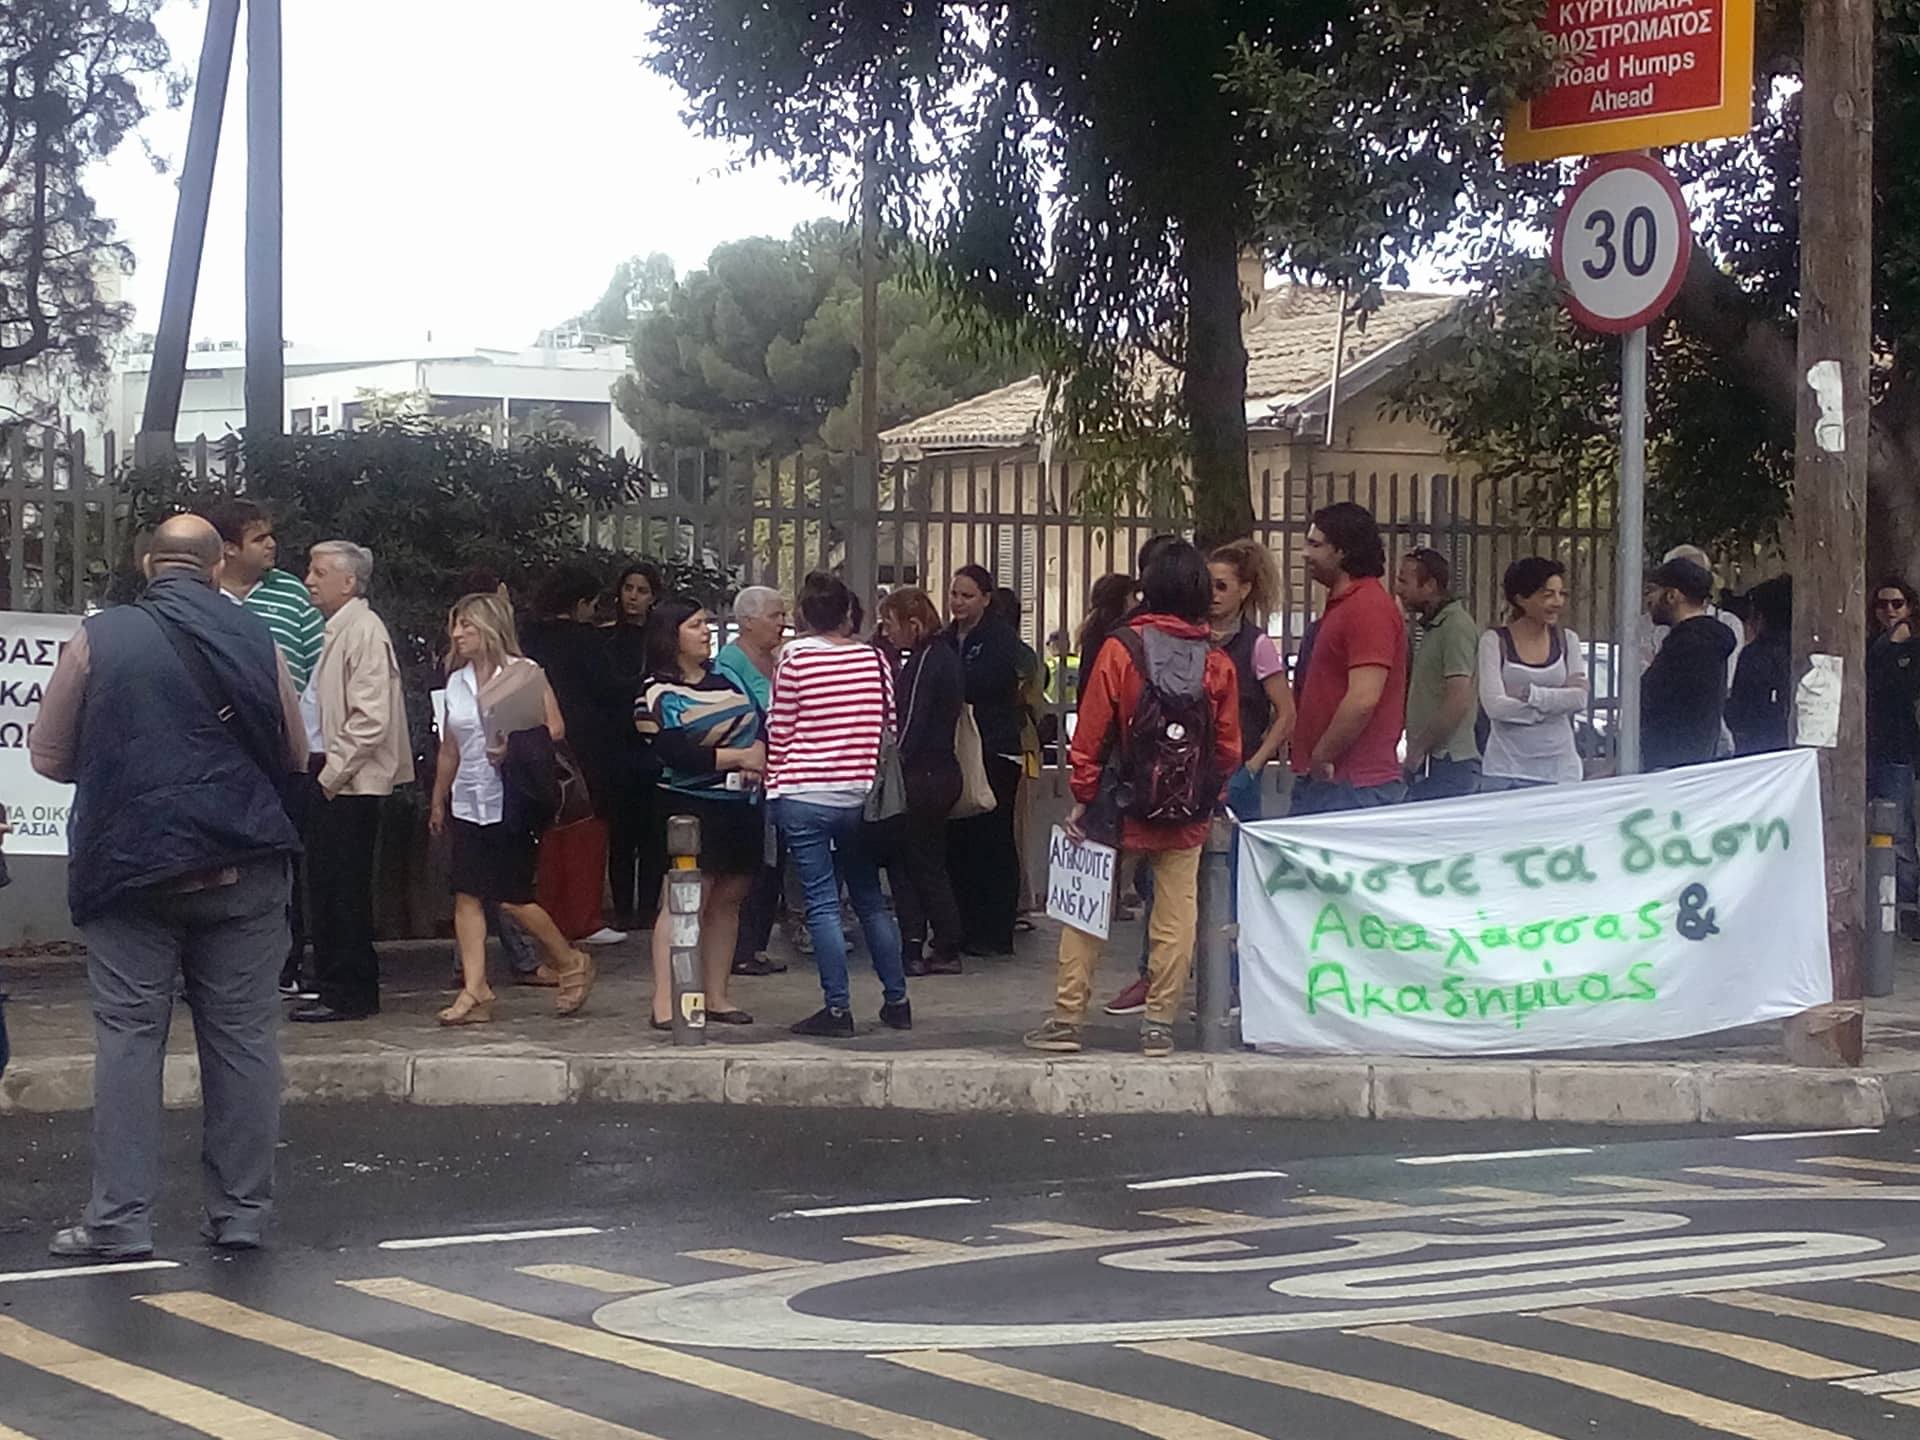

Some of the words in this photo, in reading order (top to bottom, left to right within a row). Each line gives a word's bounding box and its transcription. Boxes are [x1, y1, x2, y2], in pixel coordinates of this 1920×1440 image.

[1554, 58, 1610, 88] Road
[1619, 51, 1696, 79] Humps
[1590, 84, 1654, 113] Ahead
[1582, 206, 1657, 280] 30
[1050, 836, 1111, 881] APHRODITE
[1502, 845, 1597, 888] τα
[1619, 808, 1790, 874] δάση
[1676, 882, 1721, 941] &
